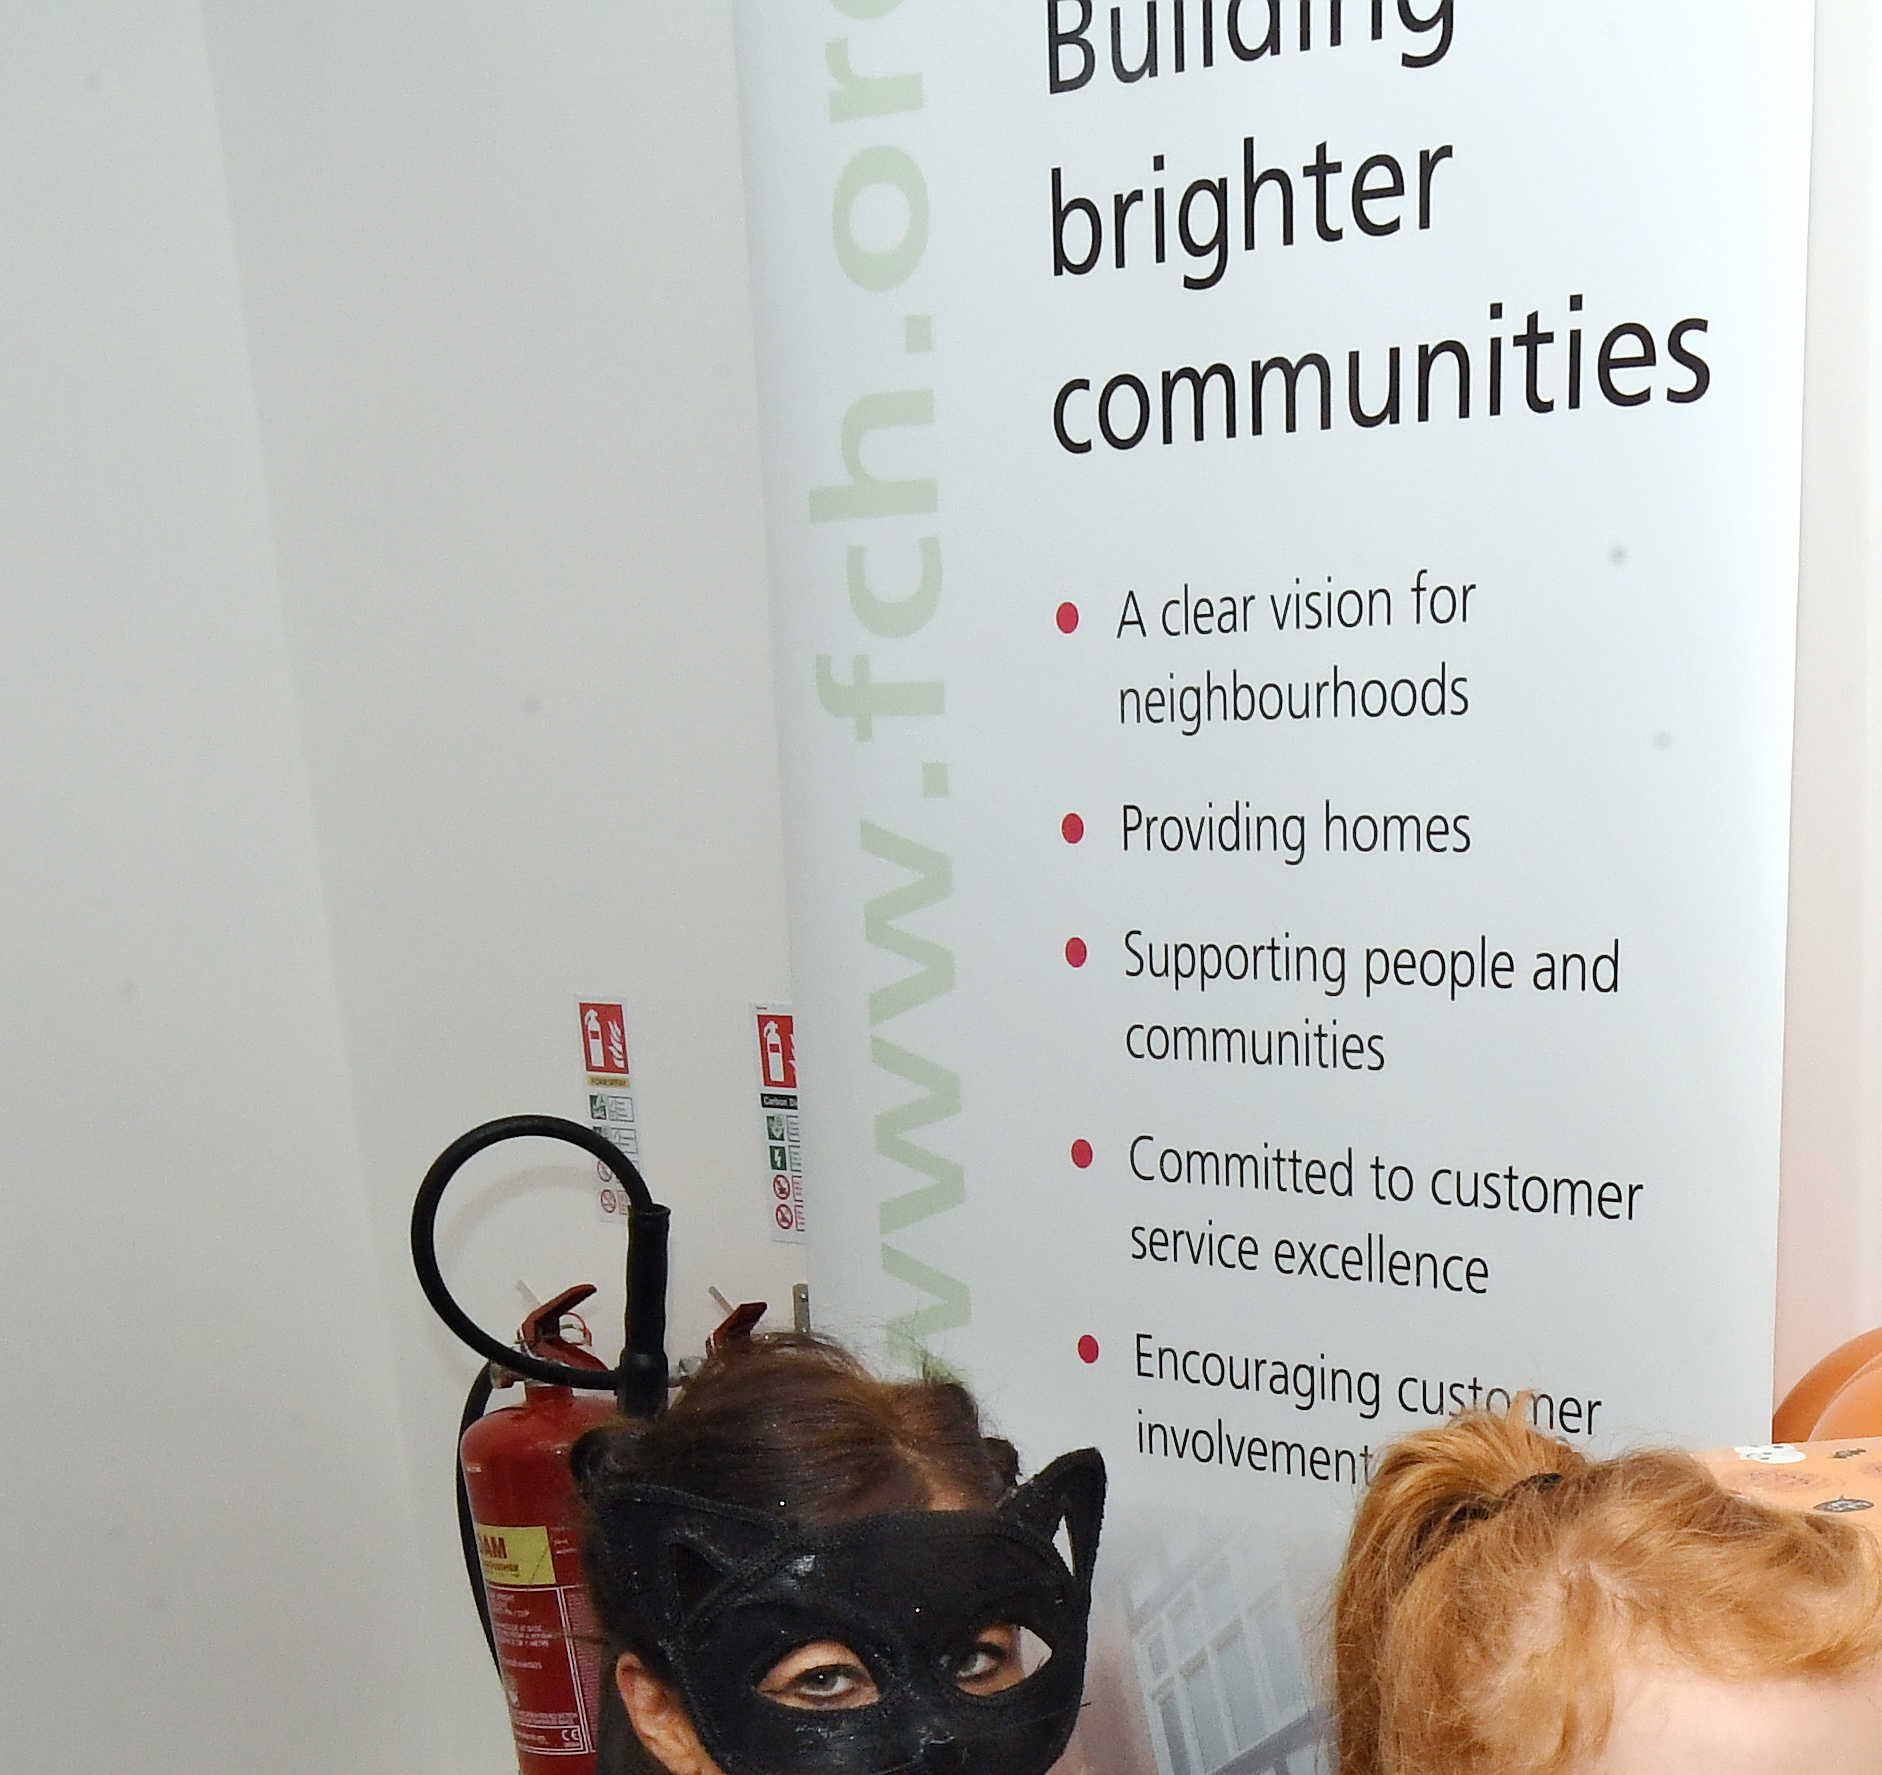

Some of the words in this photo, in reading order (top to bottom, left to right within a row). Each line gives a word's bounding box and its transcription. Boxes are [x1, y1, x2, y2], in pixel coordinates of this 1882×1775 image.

[1051, 136, 1453, 290] brighter
[1053, 294, 1711, 455] communities
[1117, 590, 1147, 639] A
[1161, 584, 1255, 637] clear
[1270, 576, 1391, 630] vision
[1411, 569, 1476, 625] for
[808, 0, 974, 1395] www.fch.or
[1120, 661, 1469, 736] neighbourhoods
[1122, 801, 1306, 865] Providing
[1325, 799, 1471, 852] homes
[1124, 930, 1345, 997] Supporting
[1366, 935, 1514, 1001] people
[1533, 938, 1619, 993] and
[1126, 1018, 1385, 1071] communities
[1129, 1134, 1353, 1198] Committed
[1371, 1154, 1414, 1201] to
[1431, 1165, 1643, 1220] customer
[1131, 1220, 1259, 1271] service
[1275, 1232, 1489, 1294] excellence
[1135, 1333, 1380, 1418] Encouraging
